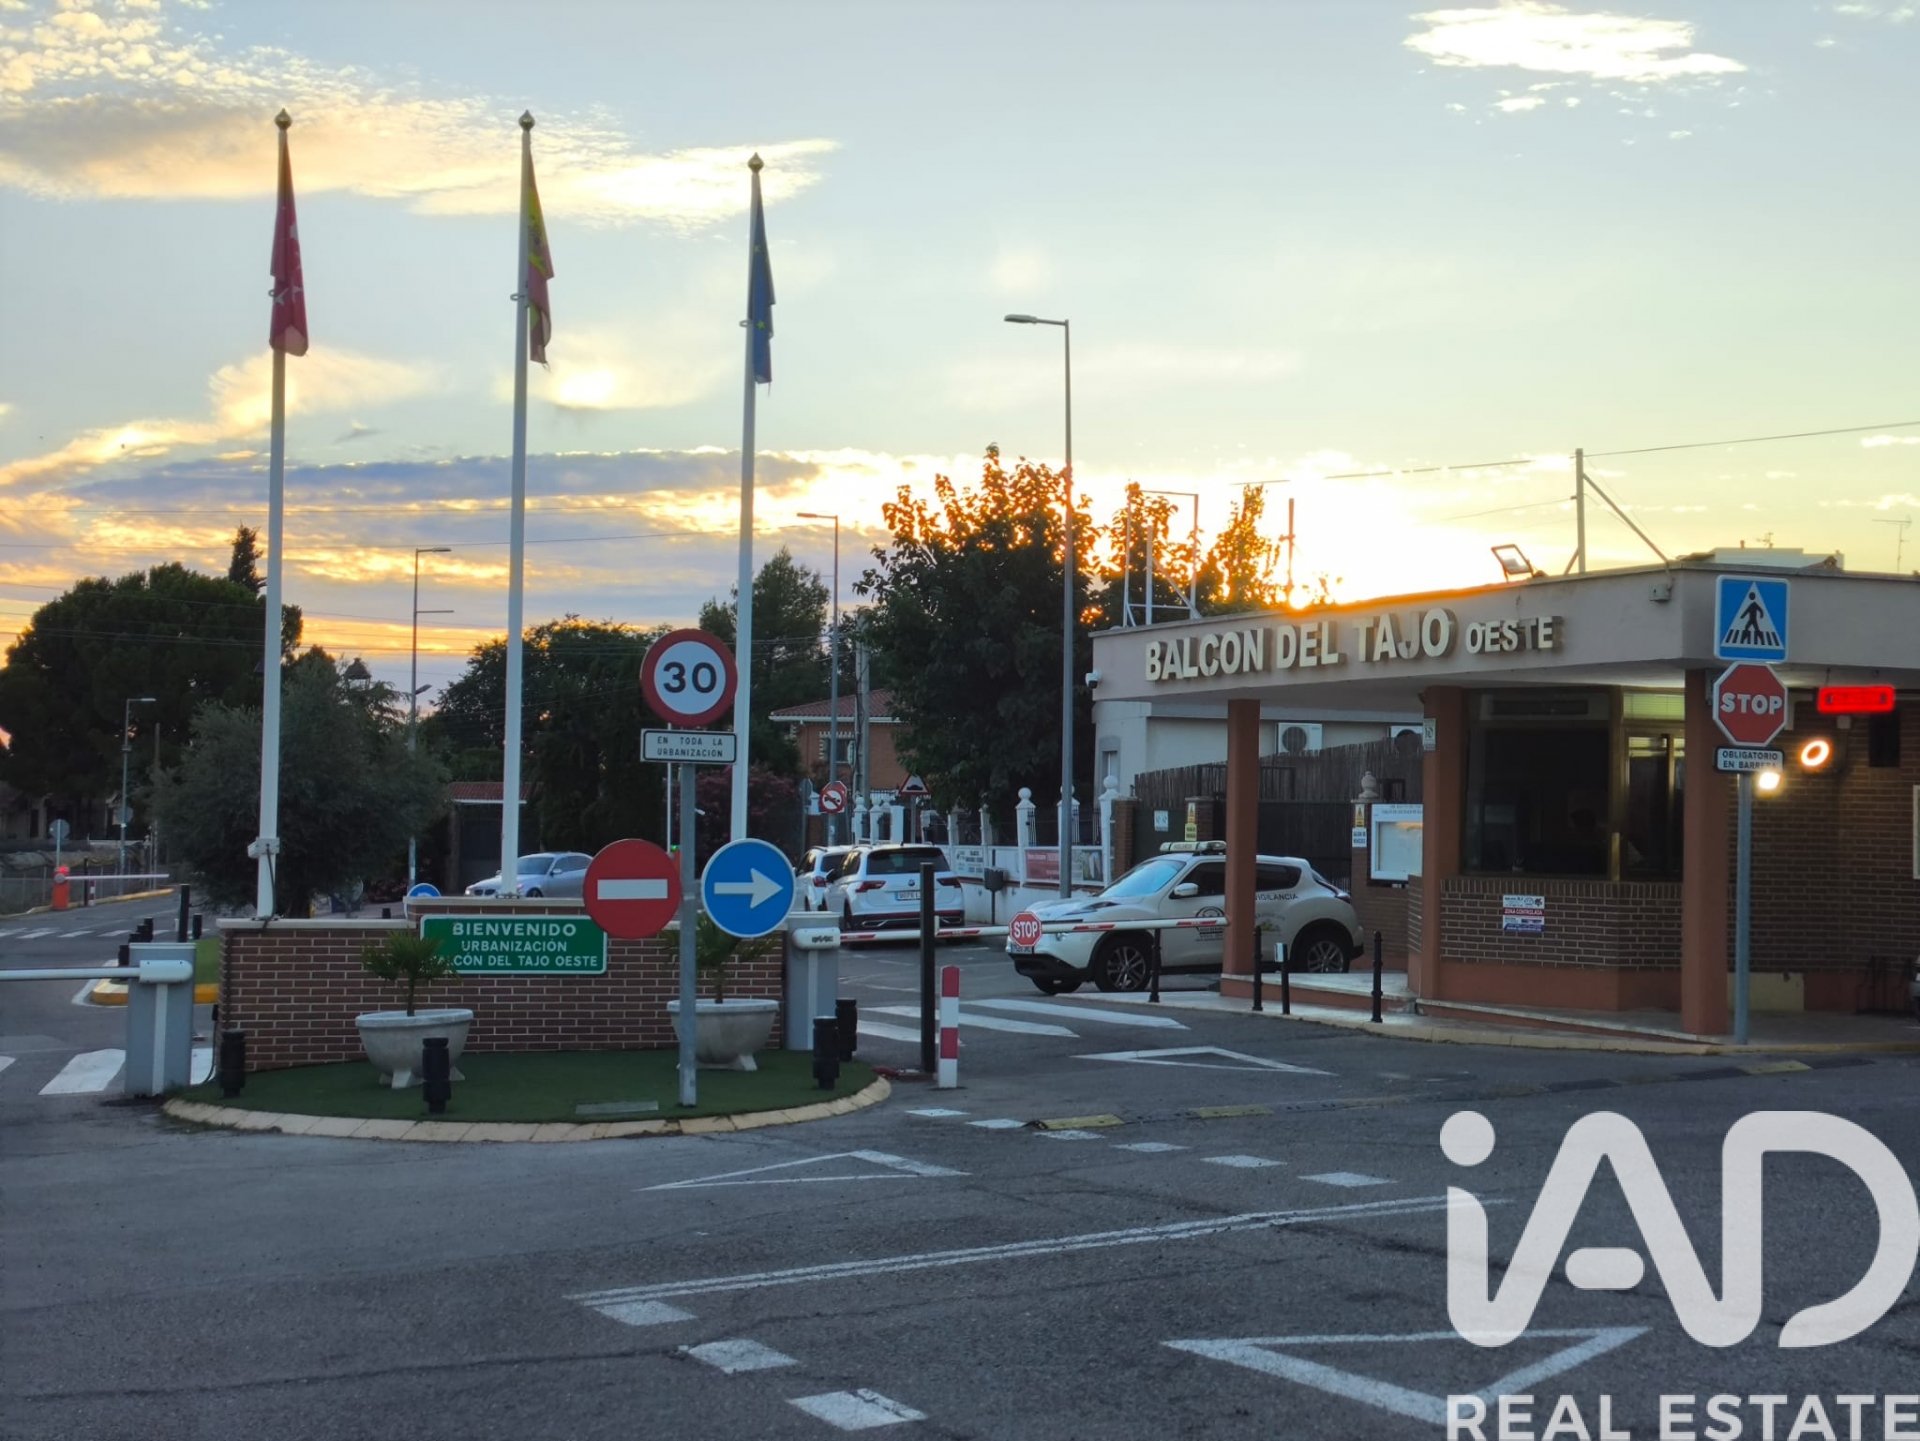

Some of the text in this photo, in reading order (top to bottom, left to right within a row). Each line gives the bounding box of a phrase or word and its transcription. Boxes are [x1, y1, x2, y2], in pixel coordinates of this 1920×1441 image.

[1145, 609, 1557, 681] BALCON DEL TAJO OESTE
[663, 661, 717, 694] 30
[1720, 692, 1783, 715] STOP
[657, 736, 723, 746] EN TODA LA
[1722, 750, 1778, 761] OBLIGATORIO
[1723, 759, 1735, 769] EN
[452, 922, 577, 936] BIENVENIDO
[1013, 921, 1038, 938] STOP
[461, 938, 567, 951] URBANIZACIÓN
[487, 954, 512, 966] DEL
[518, 955, 550, 966] TAJO
[555, 955, 598, 967] OESTE
